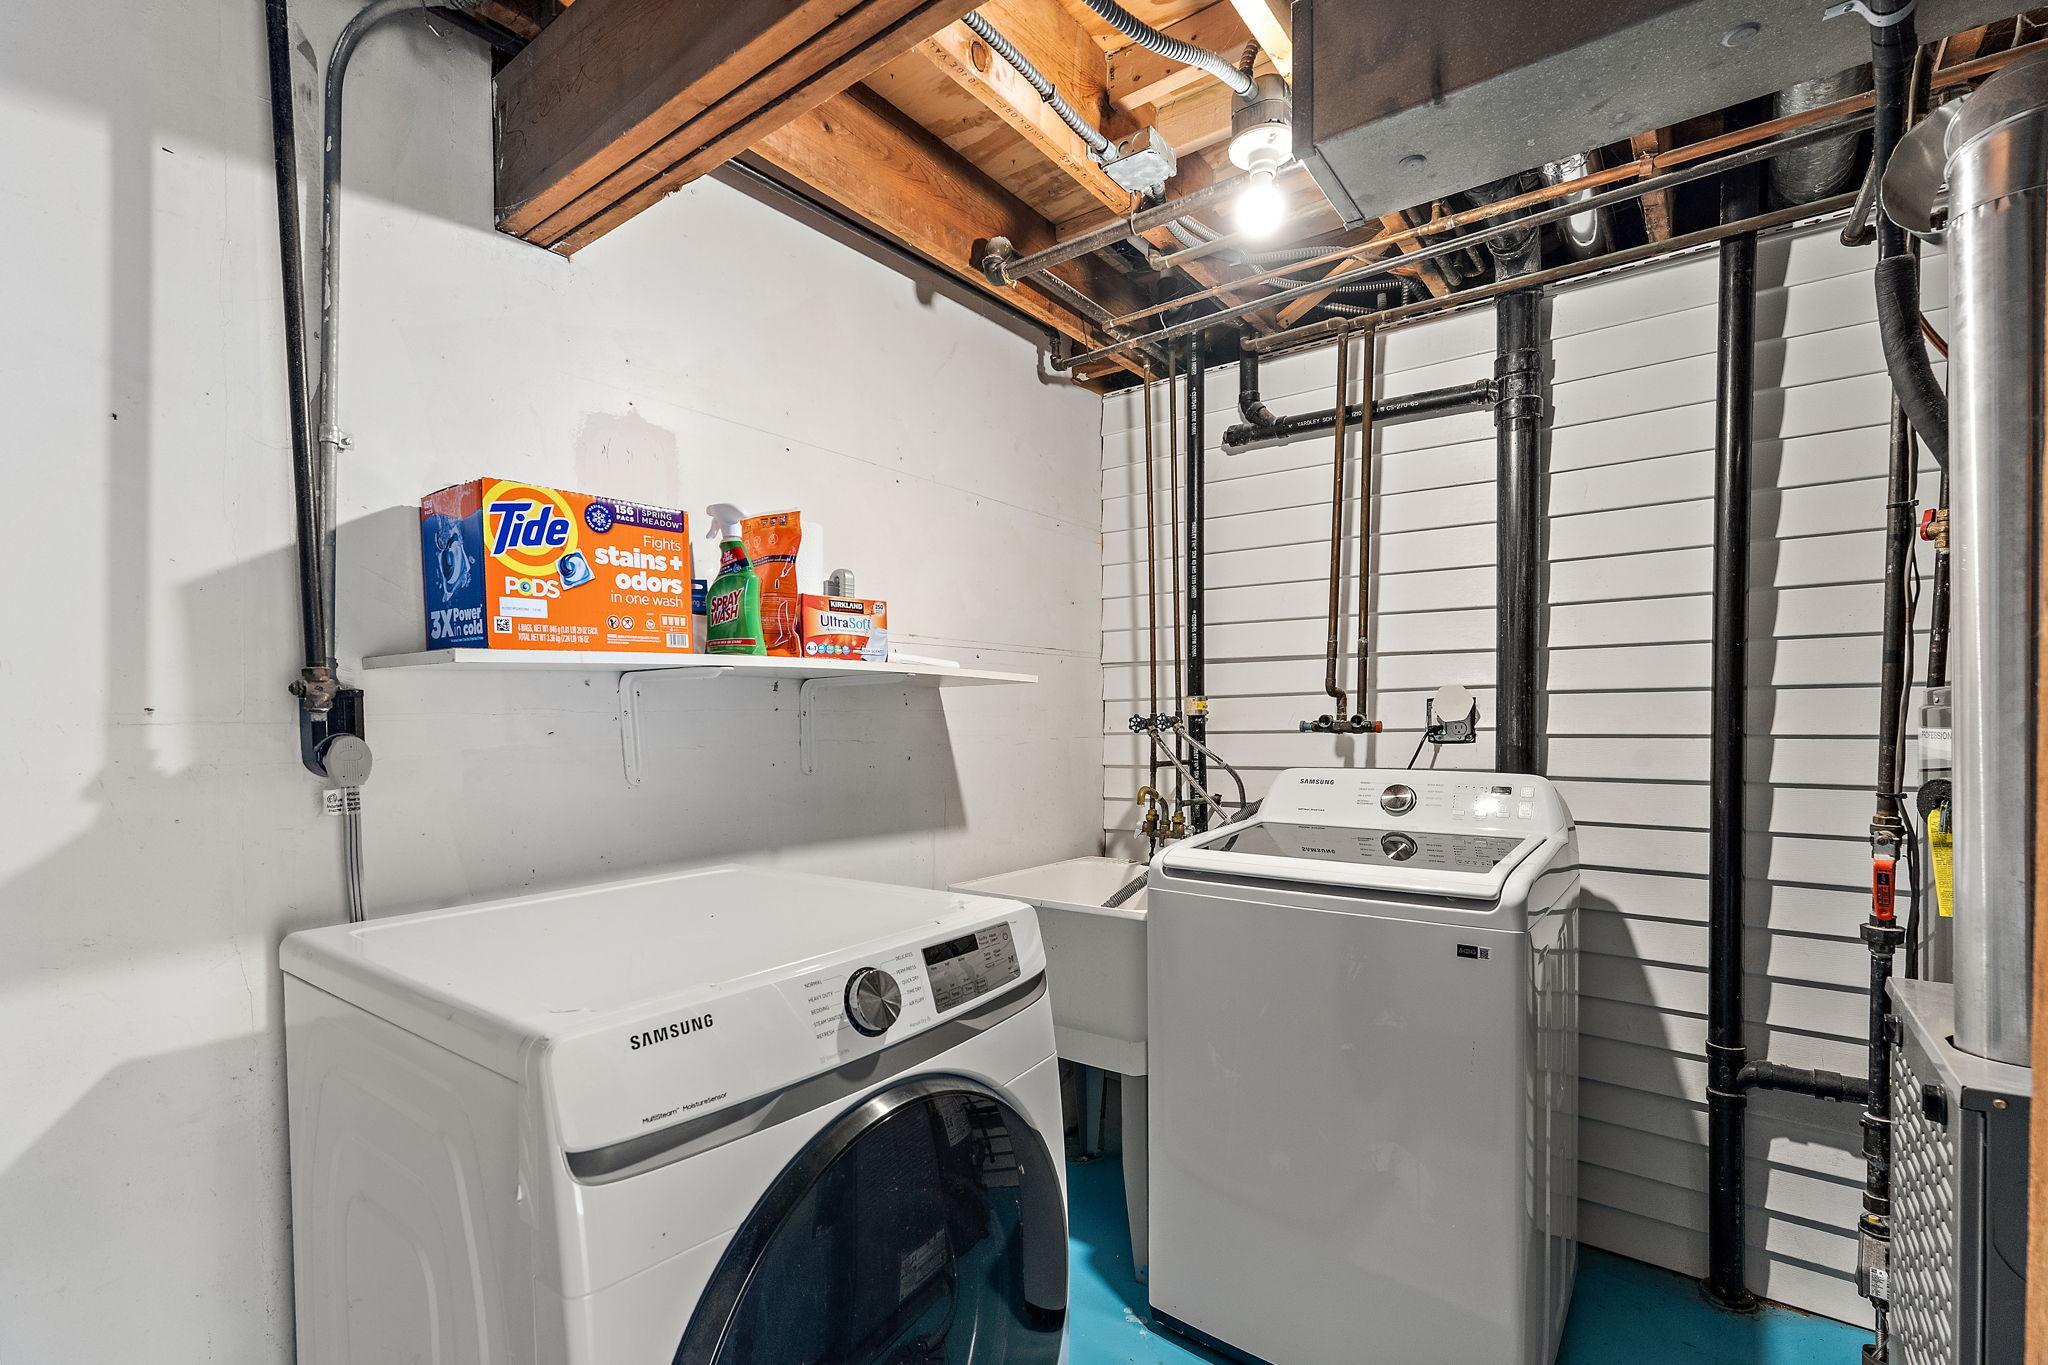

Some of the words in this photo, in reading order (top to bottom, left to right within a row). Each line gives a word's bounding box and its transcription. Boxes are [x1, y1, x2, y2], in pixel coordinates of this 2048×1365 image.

[1296, 418, 1320, 427] YARDLEY
[614, 504, 634, 516] 156
[616, 514, 635, 523] PACS
[641, 509, 672, 520] SPRING
[489, 501, 570, 556] Tide
[643, 535, 681, 552] Fights
[594, 545, 667, 571] stains
[669, 555, 683, 570] +
[505, 576, 560, 599] PODS
[615, 570, 683, 595] odors
[611, 590, 622, 603] in
[625, 594, 650, 605] one
[652, 595, 683, 608] wash
[711, 587, 744, 612] SPRAY
[830, 601, 863, 610] KIRKLAND
[453, 607, 482, 621] Power
[711, 604, 739, 626] WASH
[820, 614, 871, 630] UltraSoft
[431, 609, 454, 640] 3X
[453, 622, 462, 637] in
[463, 619, 483, 636] cold
[1299, 778, 1335, 786] SAMSUNG
[804, 980, 823, 989] NORMAL
[808, 995, 822, 1003] HEAVY
[821, 991, 833, 1000] DUTY
[630, 1013, 714, 1050] SAMSUNG
[682, 1091, 728, 1111] MoistureSensor
